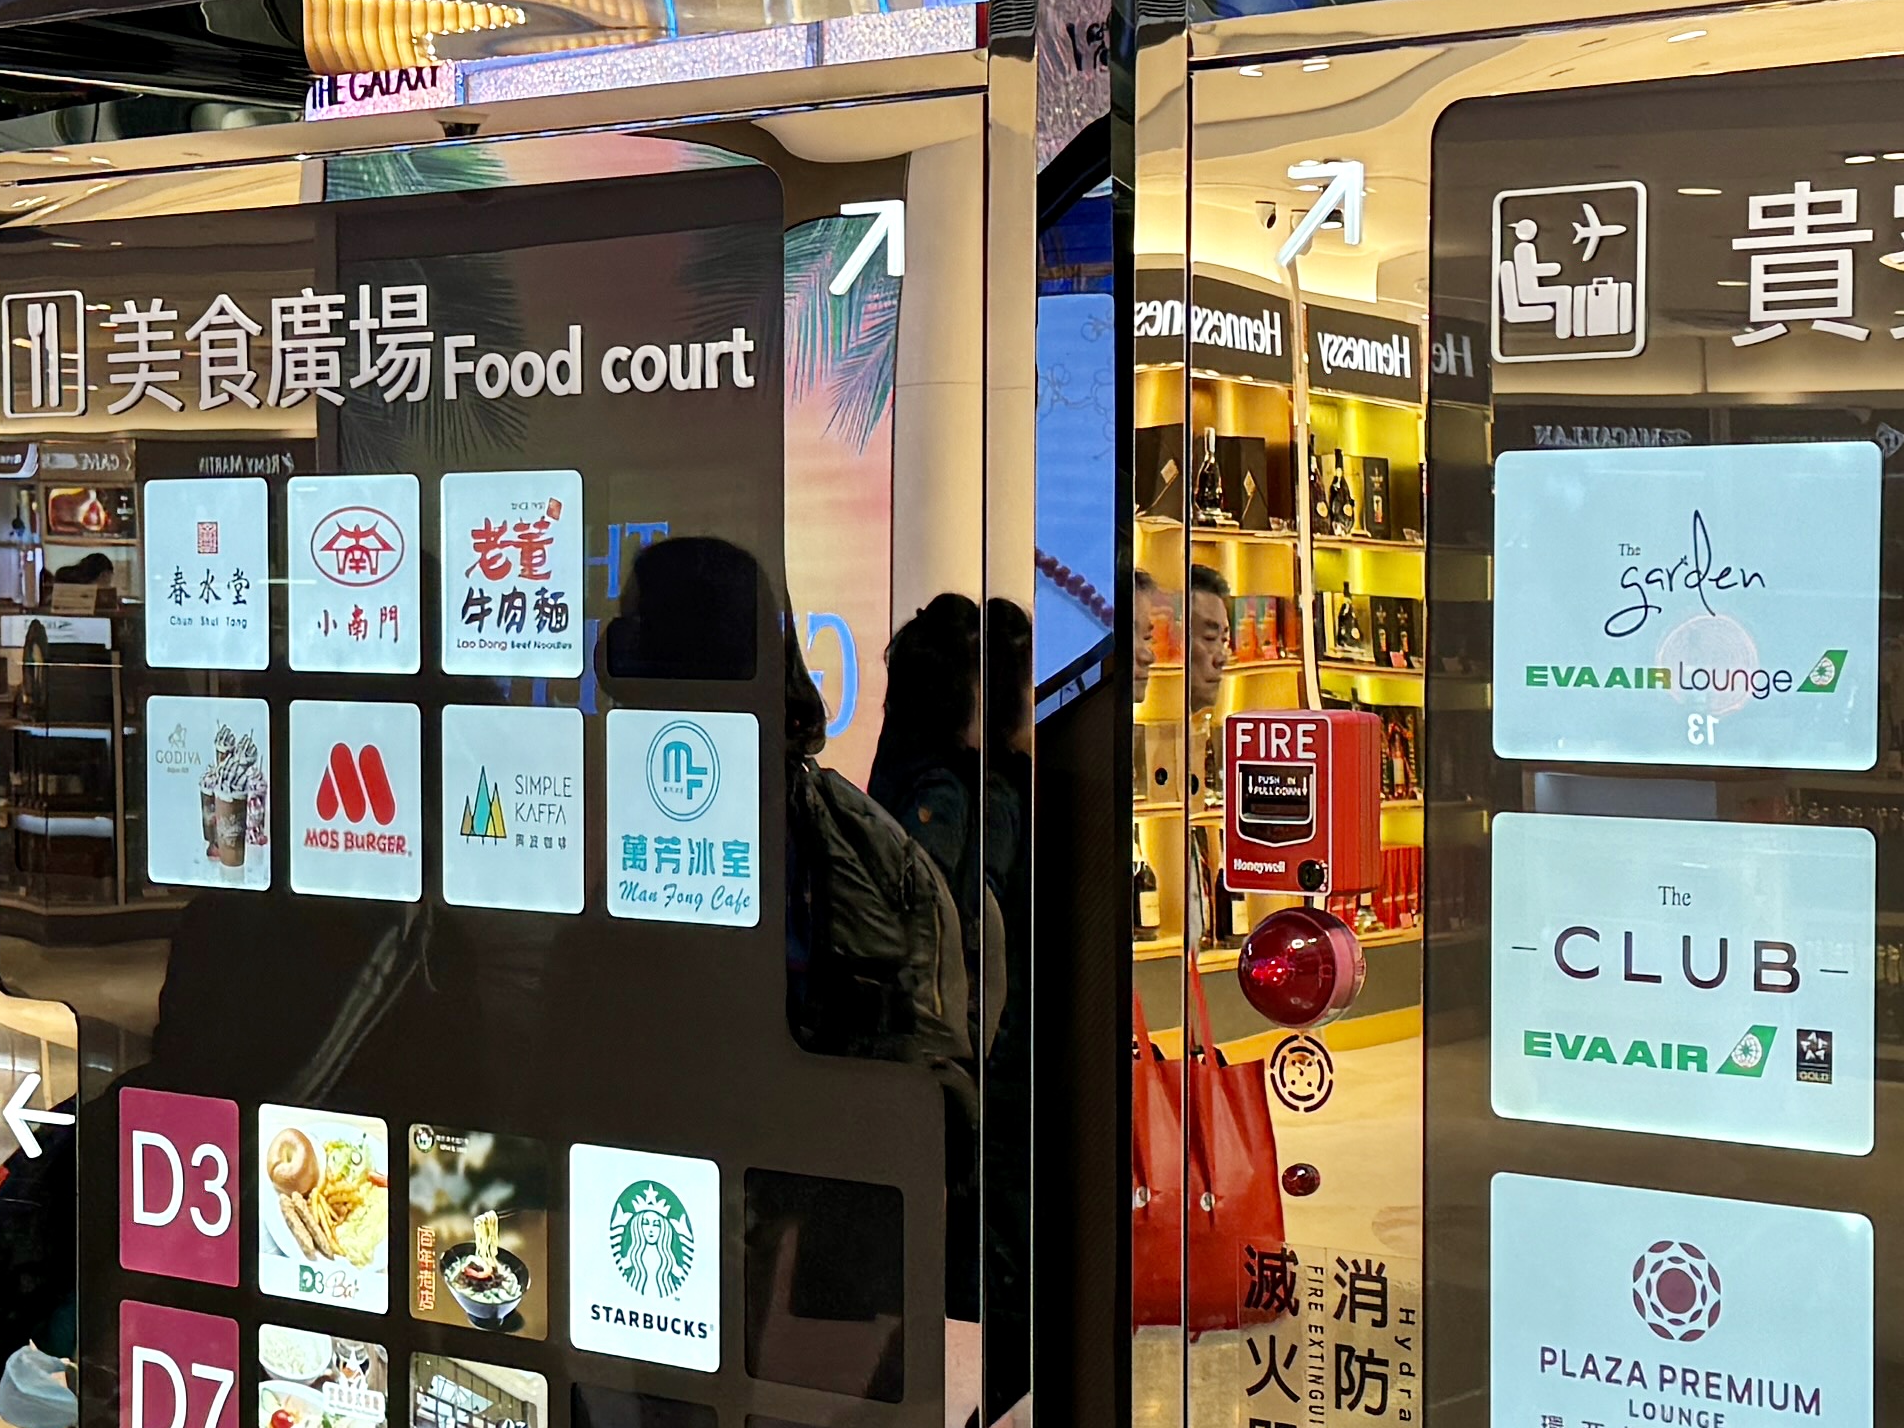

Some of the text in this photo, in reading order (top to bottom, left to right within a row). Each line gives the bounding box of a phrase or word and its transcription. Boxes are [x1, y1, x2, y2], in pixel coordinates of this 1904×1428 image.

[106, 283, 434, 415] 美食廣場
[445, 325, 755, 400] Food court
[1617, 541, 1642, 558] The
[168, 566, 250, 607] 春水堂
[1603, 509, 1766, 638] garden
[317, 605, 398, 643] 小南門
[1677, 665, 1794, 701] Lounge
[155, 749, 201, 765] GODIVA
[1235, 722, 1317, 760] FIRE
[515, 775, 573, 798] SIMPLE
[1258, 775, 1280, 785] PUSH
[515, 803, 567, 825] KAFFA
[304, 829, 407, 855] MOS BURGER
[621, 834, 751, 879] 萬芳冰室
[1233, 858, 1286, 874] Honeywell
[618, 880, 658, 904] Man
[710, 885, 751, 915] Cafe
[1657, 885, 1692, 908] The
[1553, 926, 1801, 994] CLUB
[131, 1130, 231, 1238] D3
[1306, 1265, 1325, 1311] FIRE
[589, 1302, 710, 1340] STARBUCKS
[1539, 1345, 1823, 1418] PLAZA PREMIUM
